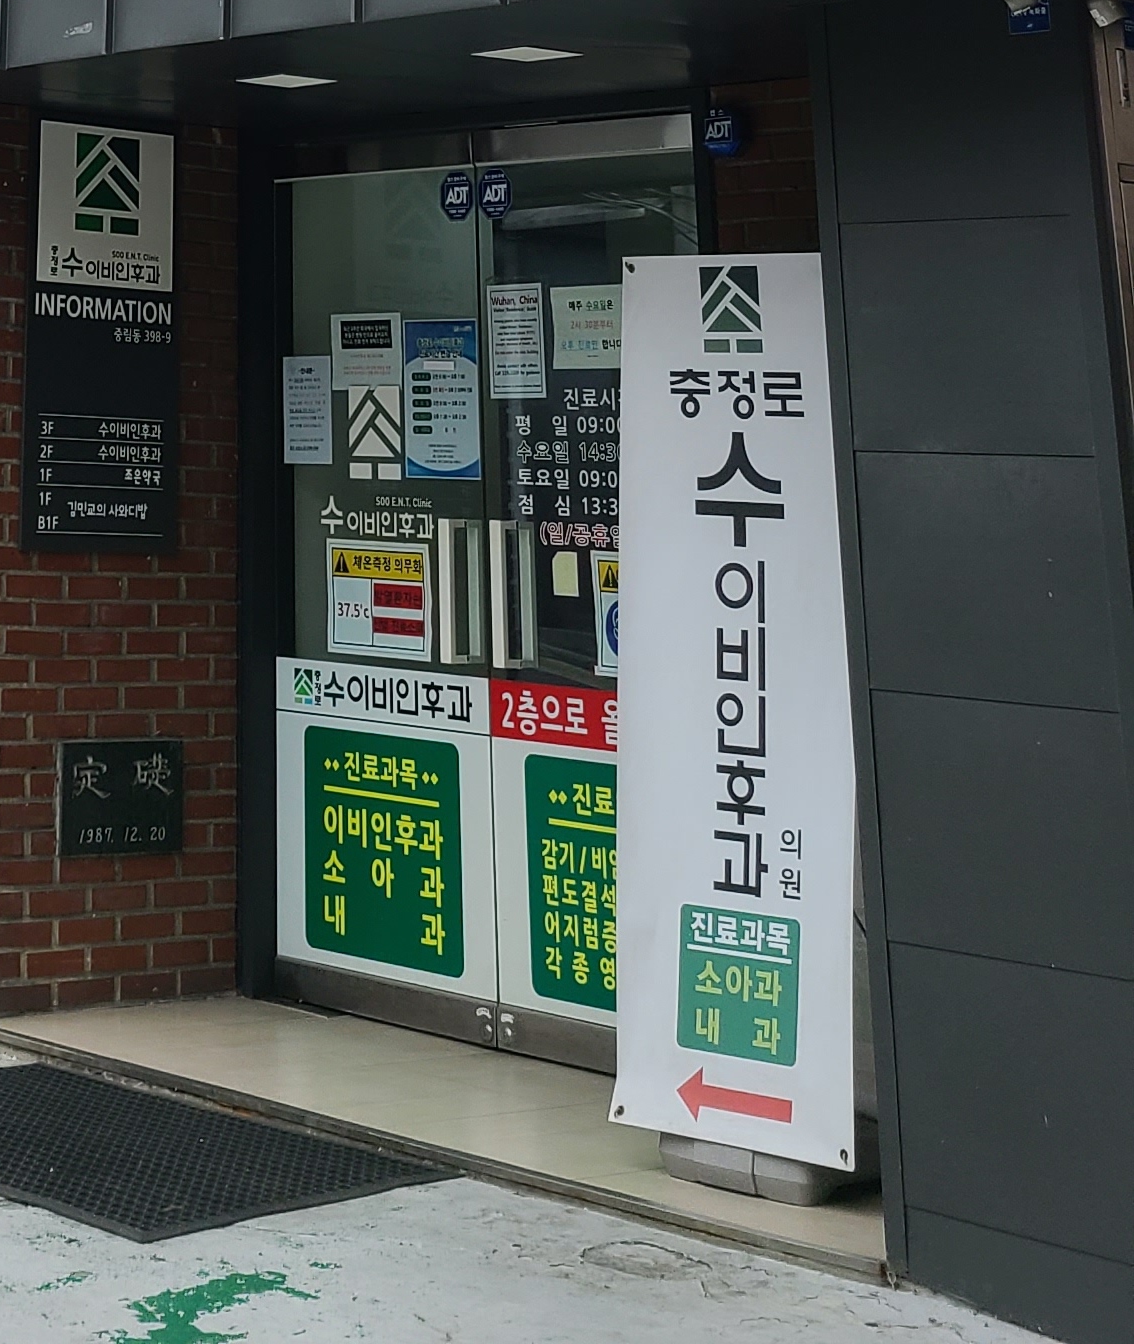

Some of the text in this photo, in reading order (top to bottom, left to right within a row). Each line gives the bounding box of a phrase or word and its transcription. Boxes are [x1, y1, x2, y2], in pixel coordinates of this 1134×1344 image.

[704, 120, 732, 140] ADT
[444, 186, 469, 205] ADT
[482, 183, 507, 204] ADT
[34, 292, 172, 325] INFORMATION
[519, 294, 538, 304] China
[568, 299, 614, 311] 매주 수요일은
[113, 327, 172, 344] 중림동 398-9
[563, 387, 619, 412] 진료시
[669, 368, 805, 420] 충정로
[40, 420, 162, 441] 3F 수이비인후과
[39, 444, 162, 463] 2F 수이비인후과
[516, 440, 569, 464] 수요일
[39, 468, 161, 486] 1F 조은약국
[516, 468, 570, 490] 토요일
[39, 491, 148, 520] 1F 김민교의 사와디밥
[412, 497, 432, 508] Clinic
[37, 515, 59, 530] B1F
[352, 555, 423, 575] 체온측정 의무화
[323, 671, 472, 724] 수이비인후과
[501, 689, 588, 737] 2층으로
[344, 751, 419, 791] 진료과목
[150, 826, 166, 841] 20
[323, 804, 444, 861] 이비인후과
[690, 911, 791, 955] 진료과목
[694, 959, 783, 1007] 소아과
